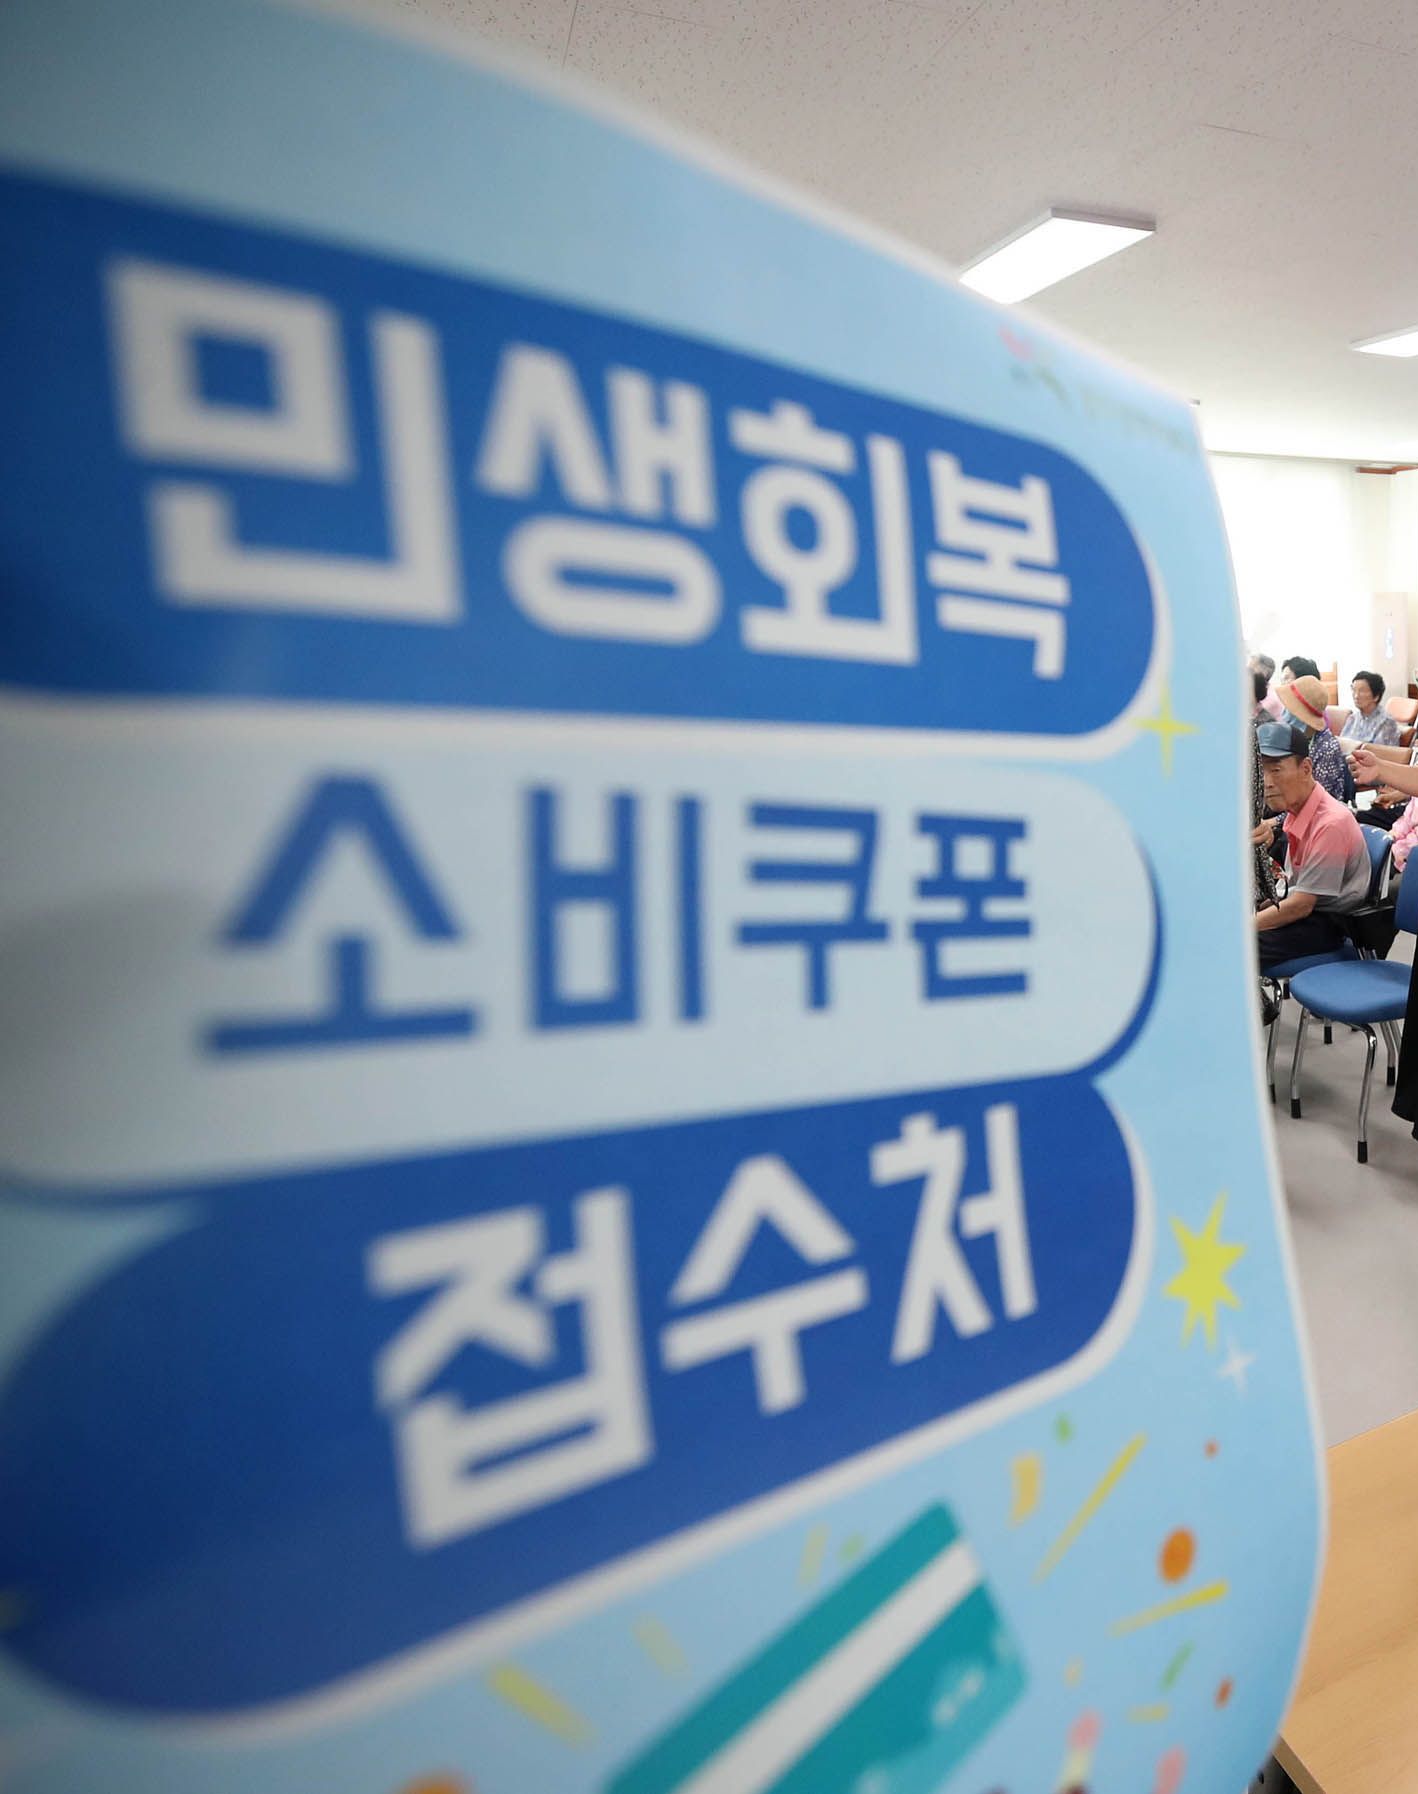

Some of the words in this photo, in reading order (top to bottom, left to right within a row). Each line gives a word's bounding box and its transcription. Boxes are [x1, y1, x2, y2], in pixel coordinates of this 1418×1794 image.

[103, 252, 1072, 680] 민생회복
[196, 772, 1036, 1062] 소비쿠폰
[366, 1104, 1039, 1552] 접수처
